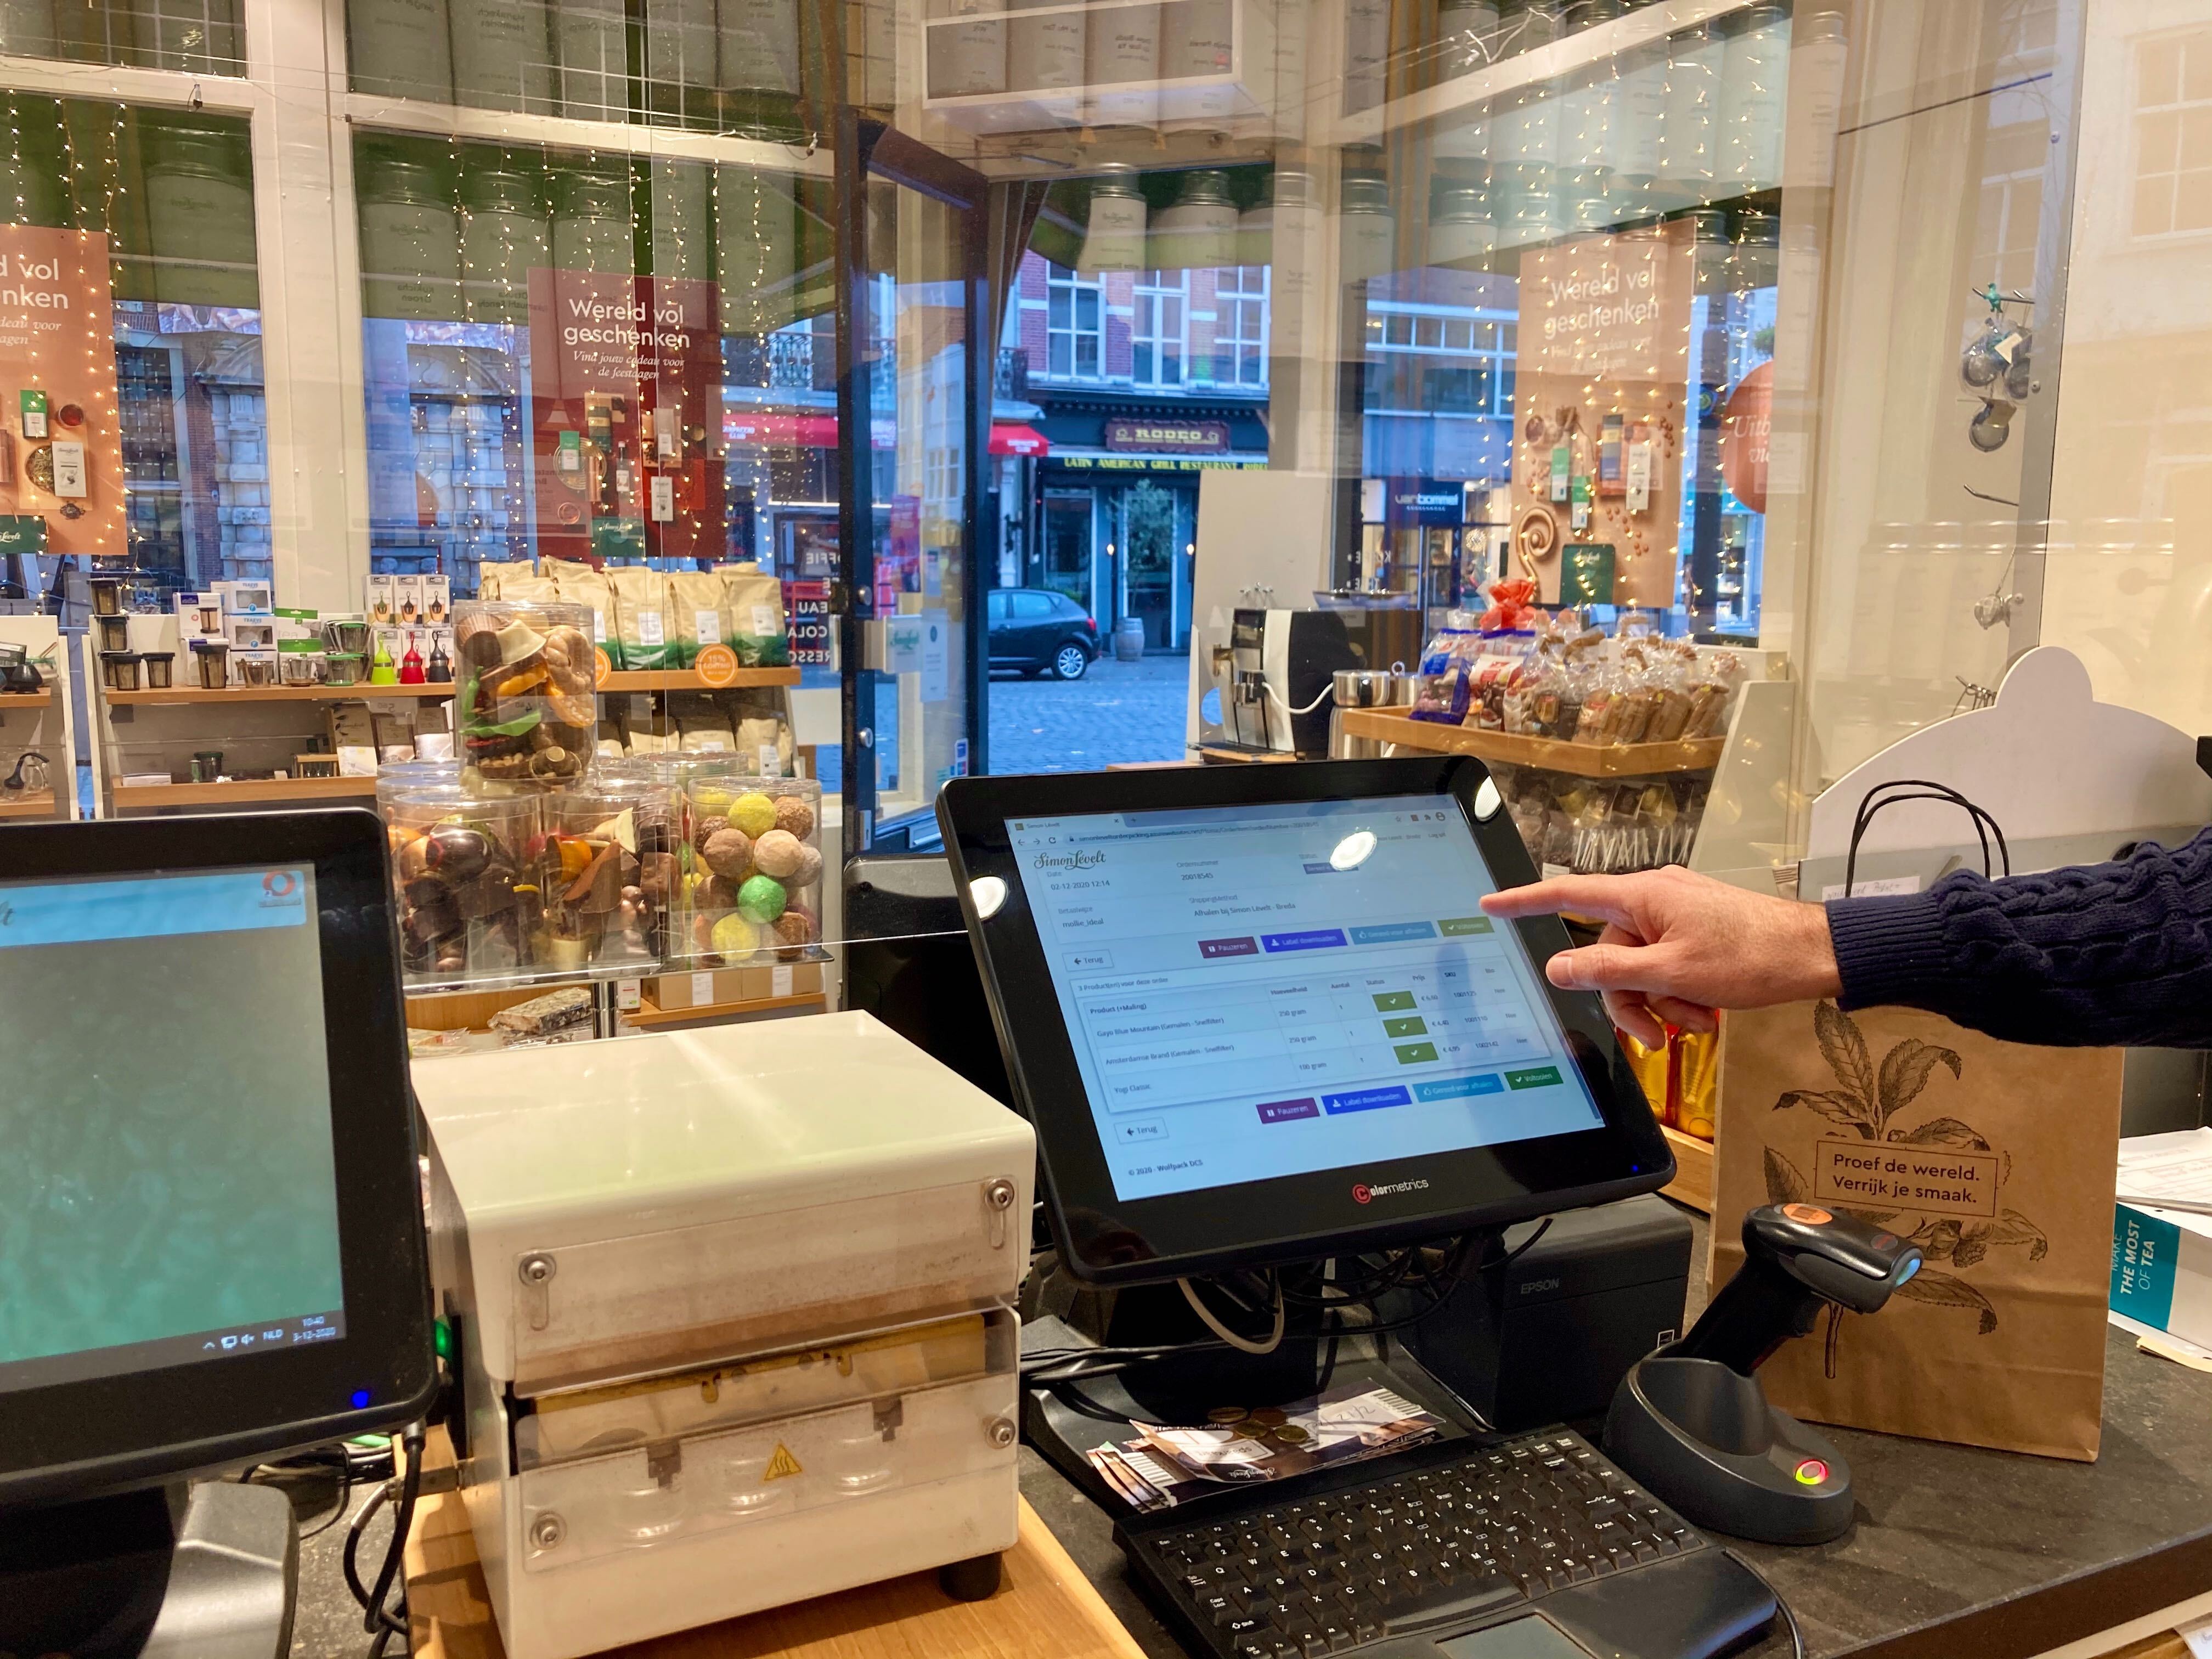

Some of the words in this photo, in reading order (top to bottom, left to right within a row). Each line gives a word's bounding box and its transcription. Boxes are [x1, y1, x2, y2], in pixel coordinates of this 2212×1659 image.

[18, 258, 59, 280] vol
[1551, 264, 1620, 302] Wereld
[1626, 260, 1656, 290] vol
[0, 284, 69, 309] nken
[569, 298, 646, 321] Wereld
[653, 304, 684, 324] vol
[1544, 296, 1659, 340] geschenken
[32, 321, 61, 331] voor
[563, 324, 690, 348] geschenken
[598, 352, 623, 365] jouw
[626, 354, 659, 366] cadeau
[599, 367, 609, 376] de
[1135, 428, 1202, 439] RODEO
[1064, 458, 1092, 467] LATIN
[1098, 459, 1146, 469] AMERICAN
[1150, 460, 1176, 470] GRILL
[1034, 852, 1074, 869] Simon
[1065, 850, 1106, 870] Lévelt
[1091, 879, 1110, 888] 12:14
[1194, 909, 1218, 917] Afhalen
[1220, 907, 1229, 916] bij
[1231, 906, 1251, 915] Simon
[1218, 943, 1248, 952] Pauzeren
[1084, 955, 1104, 966] Terug
[1090, 1006, 1115, 1014] Product
[1130, 1024, 1161, 1033] Mountain
[1150, 1052, 1170, 1060] Brand
[1114, 1086, 1128, 1094] Yogi
[1278, 1104, 1308, 1116] Pauzeren
[1137, 1125, 1158, 1136] Terug
[1157, 1161, 1188, 1173] Wolfpack
[1189, 1159, 1203, 1167] DCS
[1833, 1153, 1881, 1171] Proef
[1884, 1159, 1907, 1173] de
[1912, 1165, 1980, 1181] wereld.
[1832, 1175, 1888, 1195] Verrijk
[1892, 1181, 1909, 1198] je
[1915, 1188, 1977, 1203] smaak.
[2124, 1220, 2141, 1264] MOST
[2141, 1240, 2155, 1267] TEA
[2120, 1265, 2135, 1295] THE
[2138, 1268, 2151, 1290] OF
[1521, 1278, 1560, 1295] EPSON
